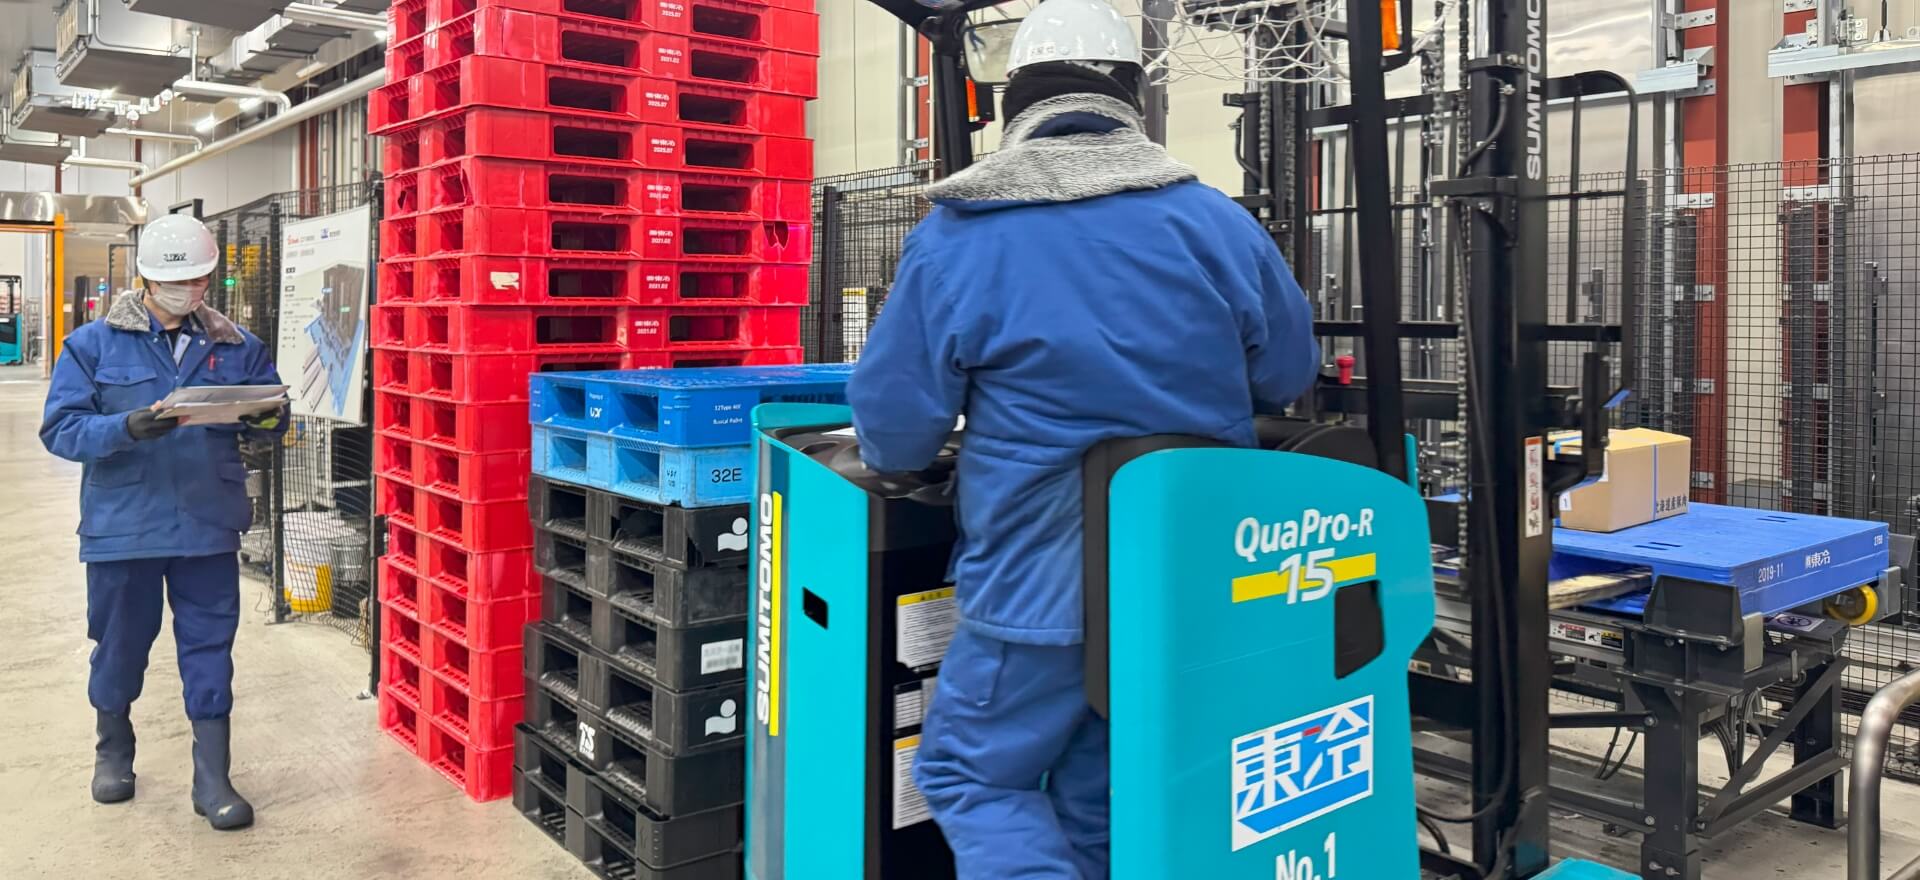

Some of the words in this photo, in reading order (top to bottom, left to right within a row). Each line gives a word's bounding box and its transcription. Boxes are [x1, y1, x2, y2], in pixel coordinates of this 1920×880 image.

[711, 467, 742, 484] 32E
[1235, 508, 1374, 563] QuaPro-R
[1278, 547, 1335, 604] 15
[1758, 562, 1784, 583] 2019-11
[757, 493, 773, 725] SUMITOMO
